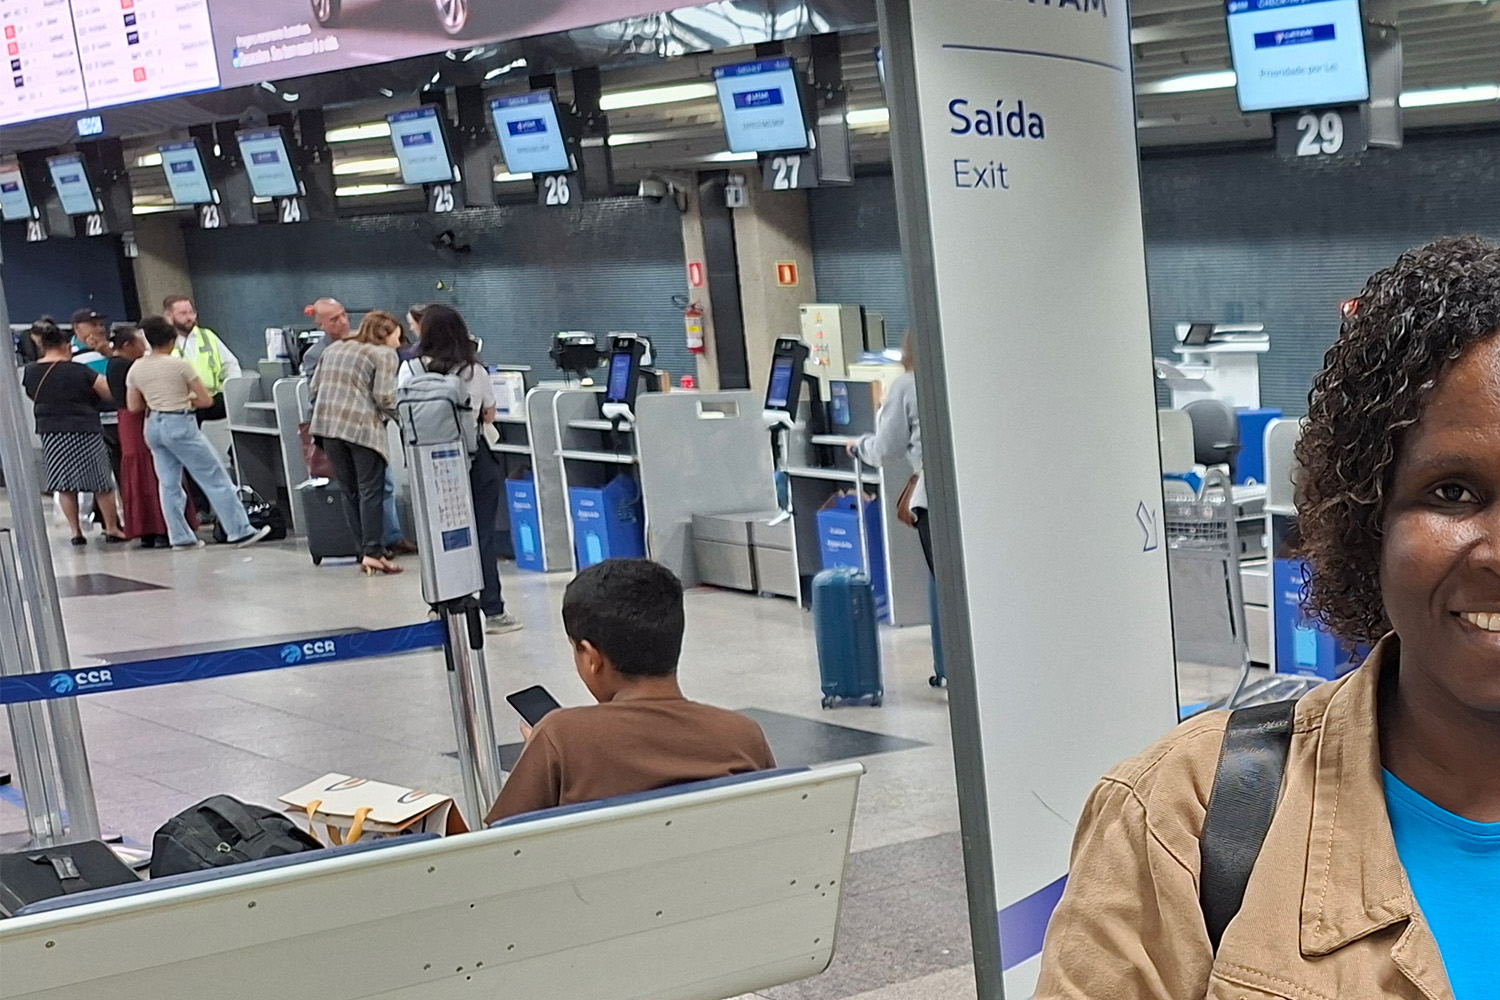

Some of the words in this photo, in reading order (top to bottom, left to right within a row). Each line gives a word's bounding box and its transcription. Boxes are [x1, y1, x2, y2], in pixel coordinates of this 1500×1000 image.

[948, 98, 1045, 140] Saída
[1296, 112, 1344, 156] 29
[771, 155, 801, 190] 27
[953, 159, 1010, 189] Exit
[433, 184, 455, 213] 25
[544, 175, 571, 205] 26
[202, 204, 220, 228] 23
[282, 197, 301, 223] 24
[28, 220, 43, 241] 21
[87, 214, 104, 236] 22
[302, 640, 336, 655] CCR
[75, 669, 112, 685] CCR
